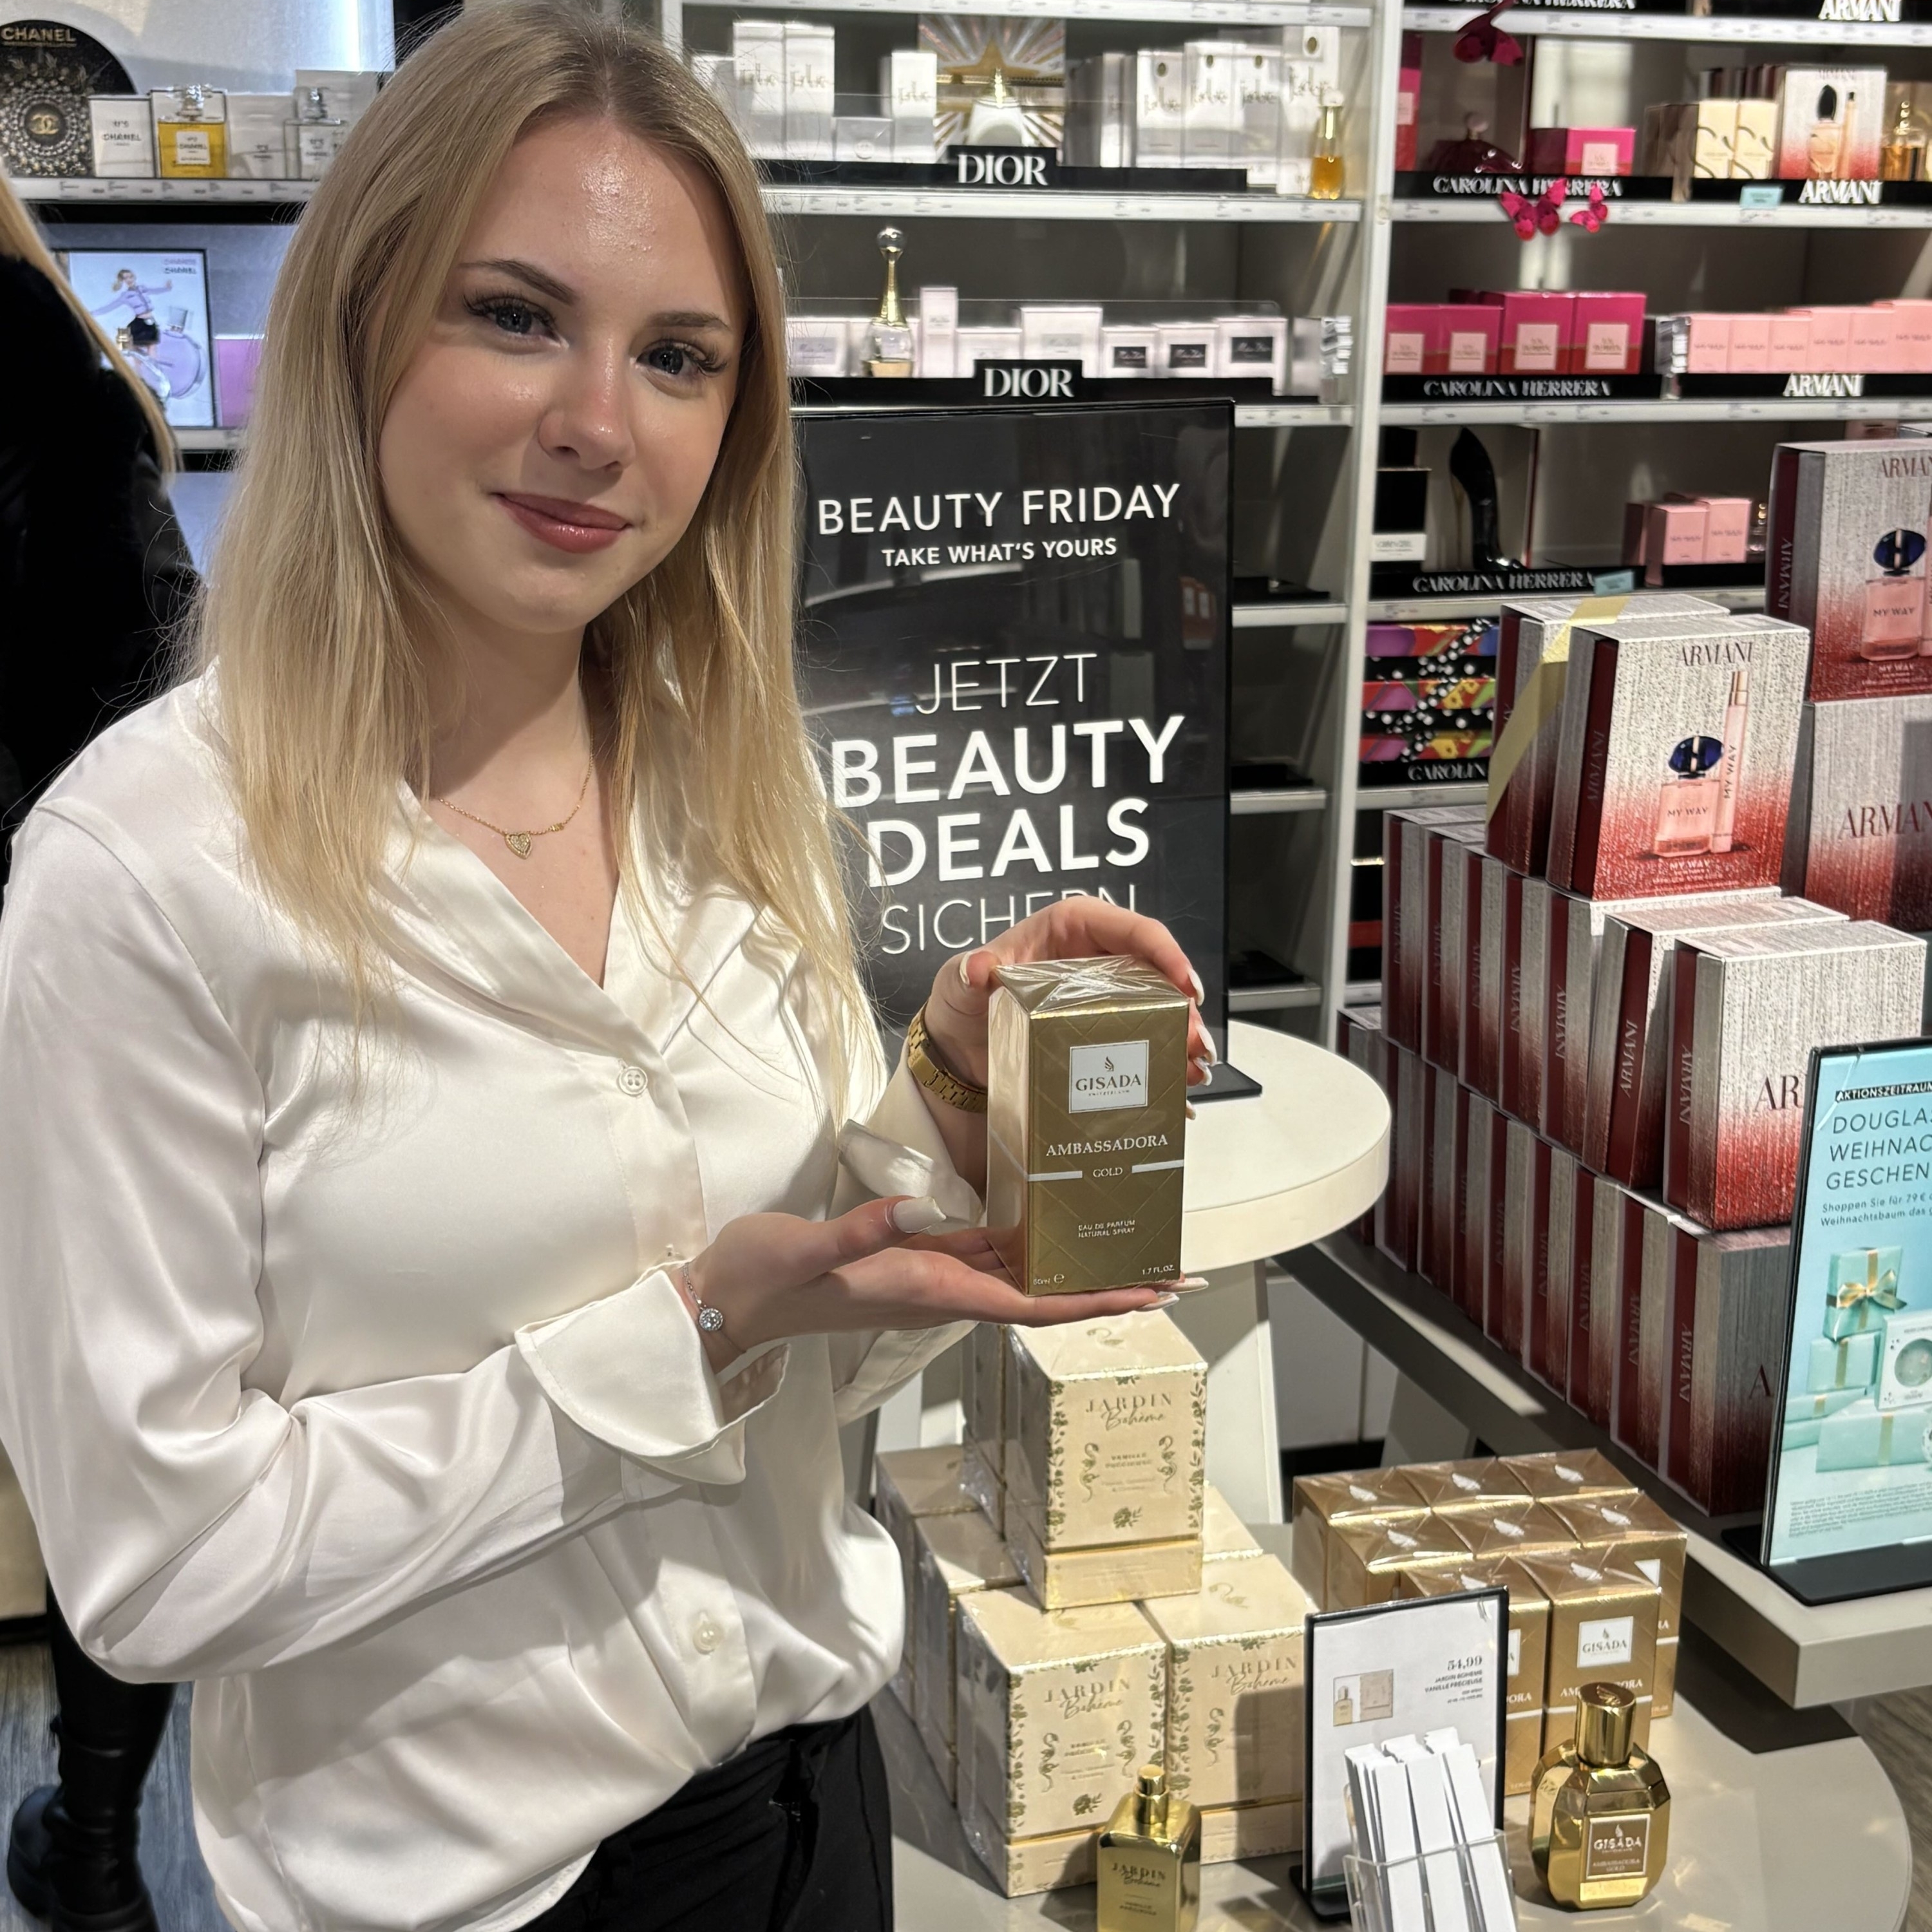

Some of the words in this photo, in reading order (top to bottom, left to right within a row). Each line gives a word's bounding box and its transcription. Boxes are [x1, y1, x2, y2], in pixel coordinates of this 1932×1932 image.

[1818, 0, 1902, 22] ARMANI
[2, 26, 77, 42] CHANEL
[958, 154, 1048, 185] DIOR
[1433, 176, 1528, 194] CAROLINA
[1532, 177, 1622, 196] HERERA
[1798, 179, 1883, 204] ARMANI
[983, 368, 1074, 398] DIOR
[1424, 380, 1517, 397] CAROLINA
[1522, 380, 1611, 397] HERRERA
[1783, 373, 1865, 396] ARMANI
[819, 492, 1003, 535] BEAUTY
[1023, 484, 1180, 525] FRIDAY
[882, 547, 941, 567] TAKE
[947, 542, 1035, 564] WHAT'S
[1042, 538, 1117, 558] YOURS
[1412, 574, 1504, 592] CAROLINA
[1777, 537, 1793, 609] ARMANI
[1678, 642, 1754, 667] ARMANI
[915, 654, 1097, 715] JETZT
[831, 715, 1185, 809] BEAUTY
[1667, 809, 1684, 818] MY
[1685, 806, 1709, 816] WAY
[867, 798, 1150, 887] DEALS
[881, 884, 1135, 955] SICH
[1620, 1019, 1639, 1098] ARMANI
[1075, 1074, 1142, 1092] GISADA
[1680, 1045, 1693, 1125] ARMANI
[1833, 1107, 1932, 1134] DOUGLA
[1046, 1134, 1168, 1157] AMBASSADORA
[1830, 1133, 1932, 1162] WEIHNAC
[1093, 1167, 1123, 1178] GOLD
[1826, 1162, 1929, 1190] GESCHEN
[1822, 1201, 1866, 1213] Shoppen
[1870, 1198, 1885, 1208] Sie
[1889, 1195, 1902, 1206] für
[1107, 1220, 1136, 1228] PARFUM
[1821, 1210, 1905, 1227] Weihnachtsbaum
[1909, 1207, 1926, 1217] das
[1078, 1229, 1110, 1238] NATURAL
[1113, 1227, 1135, 1236] SPRAY
[1680, 1323, 1693, 1403] ARMANI
[1086, 1392, 1172, 1412] JARDIN
[1582, 1640, 1627, 1654] GISADA
[1211, 1657, 1297, 1678] JARDIN
[1044, 1678, 1130, 1703] JARDIN
[1593, 1836, 1642, 1850] GISADA
